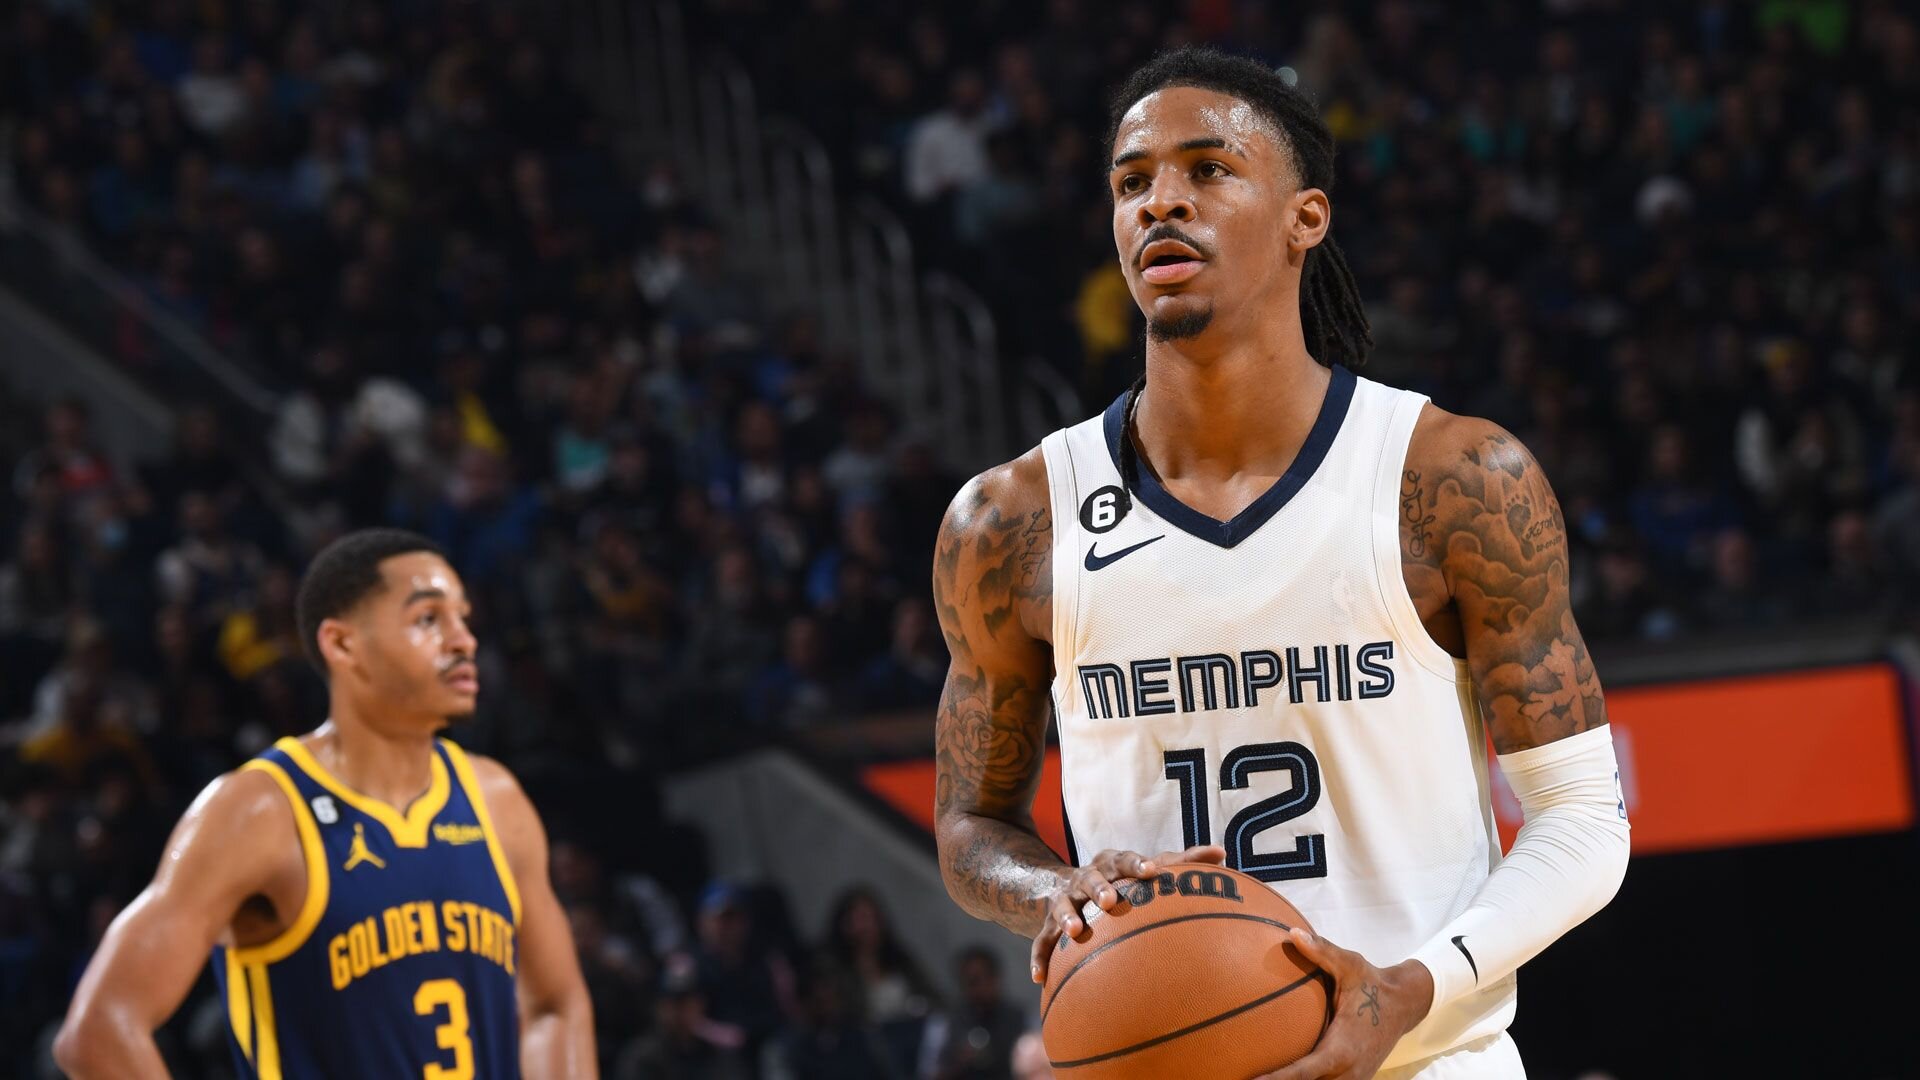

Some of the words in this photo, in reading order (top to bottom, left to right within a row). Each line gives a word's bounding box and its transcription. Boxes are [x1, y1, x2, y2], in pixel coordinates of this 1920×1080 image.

[1091, 492, 1116, 528] 6
[1078, 641, 1395, 719] MEMPHIS
[312, 796, 338, 824] 6
[1163, 741, 1328, 882] 12
[329, 900, 441, 991] GOLDEN
[441, 900, 515, 976] STATE
[413, 978, 475, 1080] 3
